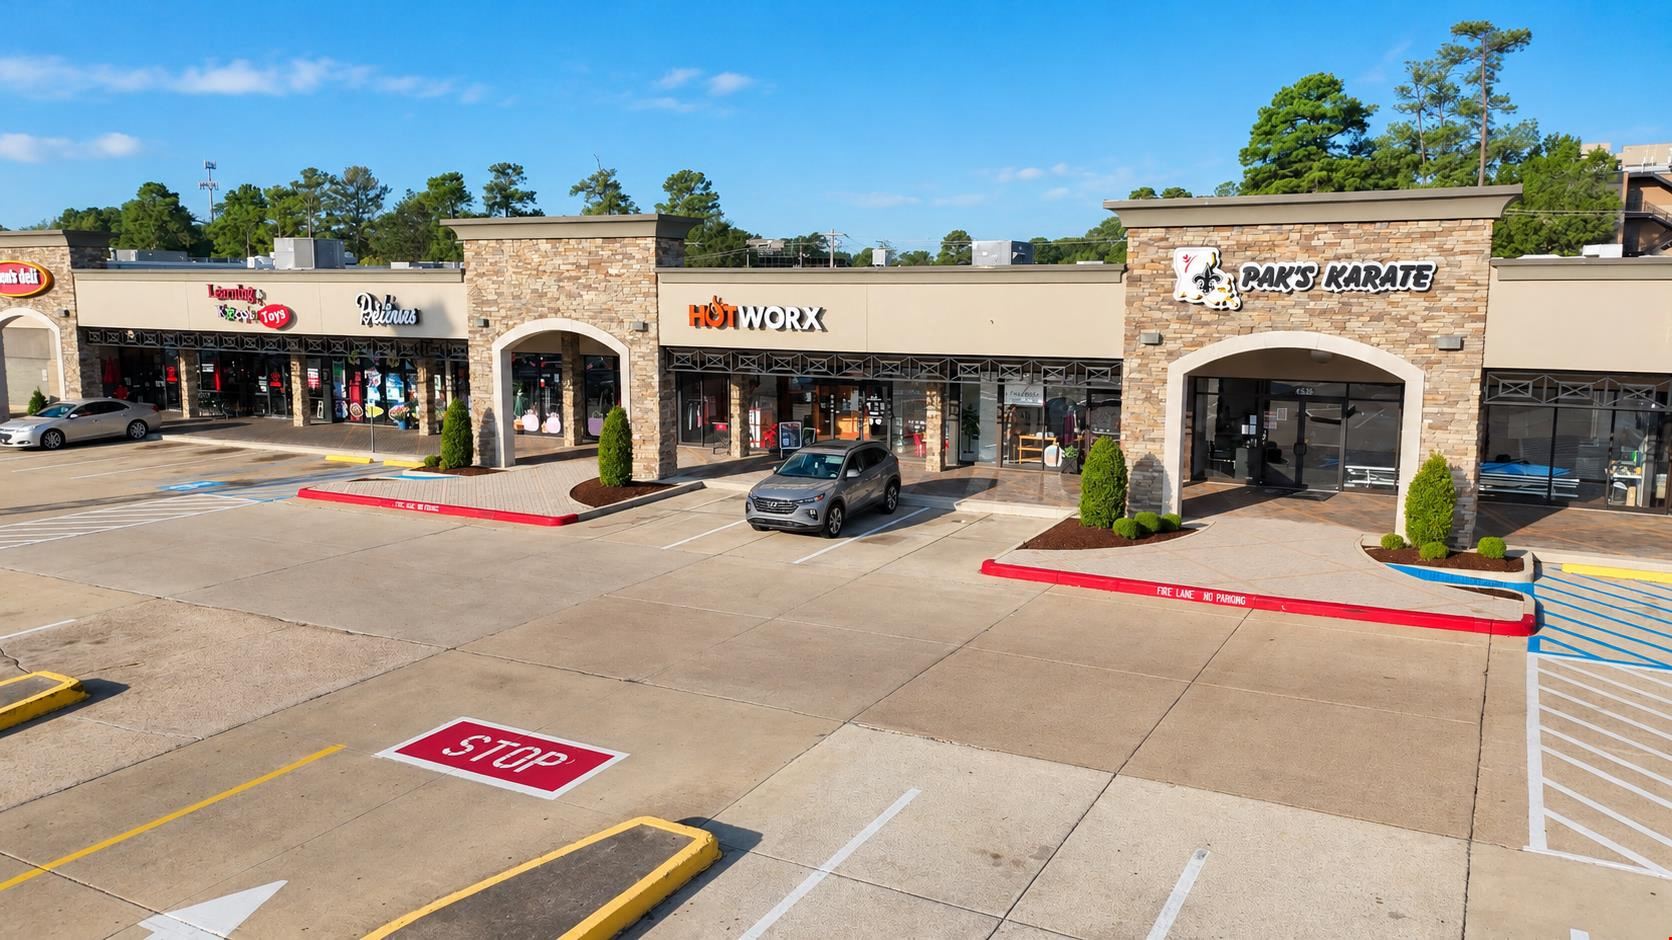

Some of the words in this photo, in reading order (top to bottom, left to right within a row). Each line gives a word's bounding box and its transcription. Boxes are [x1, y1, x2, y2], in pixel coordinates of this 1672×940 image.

[18, 267, 39, 284] deli
[1240, 263, 1317, 291] PAK'S
[1323, 263, 1434, 291] KARATE
[261, 309, 286, 323] Toys
[688, 295, 823, 330] HOTWORX
[1156, 586, 1173, 597] FIRE
[1176, 588, 1195, 599] LANE
[1203, 591, 1213, 602] NO
[1216, 593, 1246, 605] PARKING
[441, 734, 569, 773] STOP
